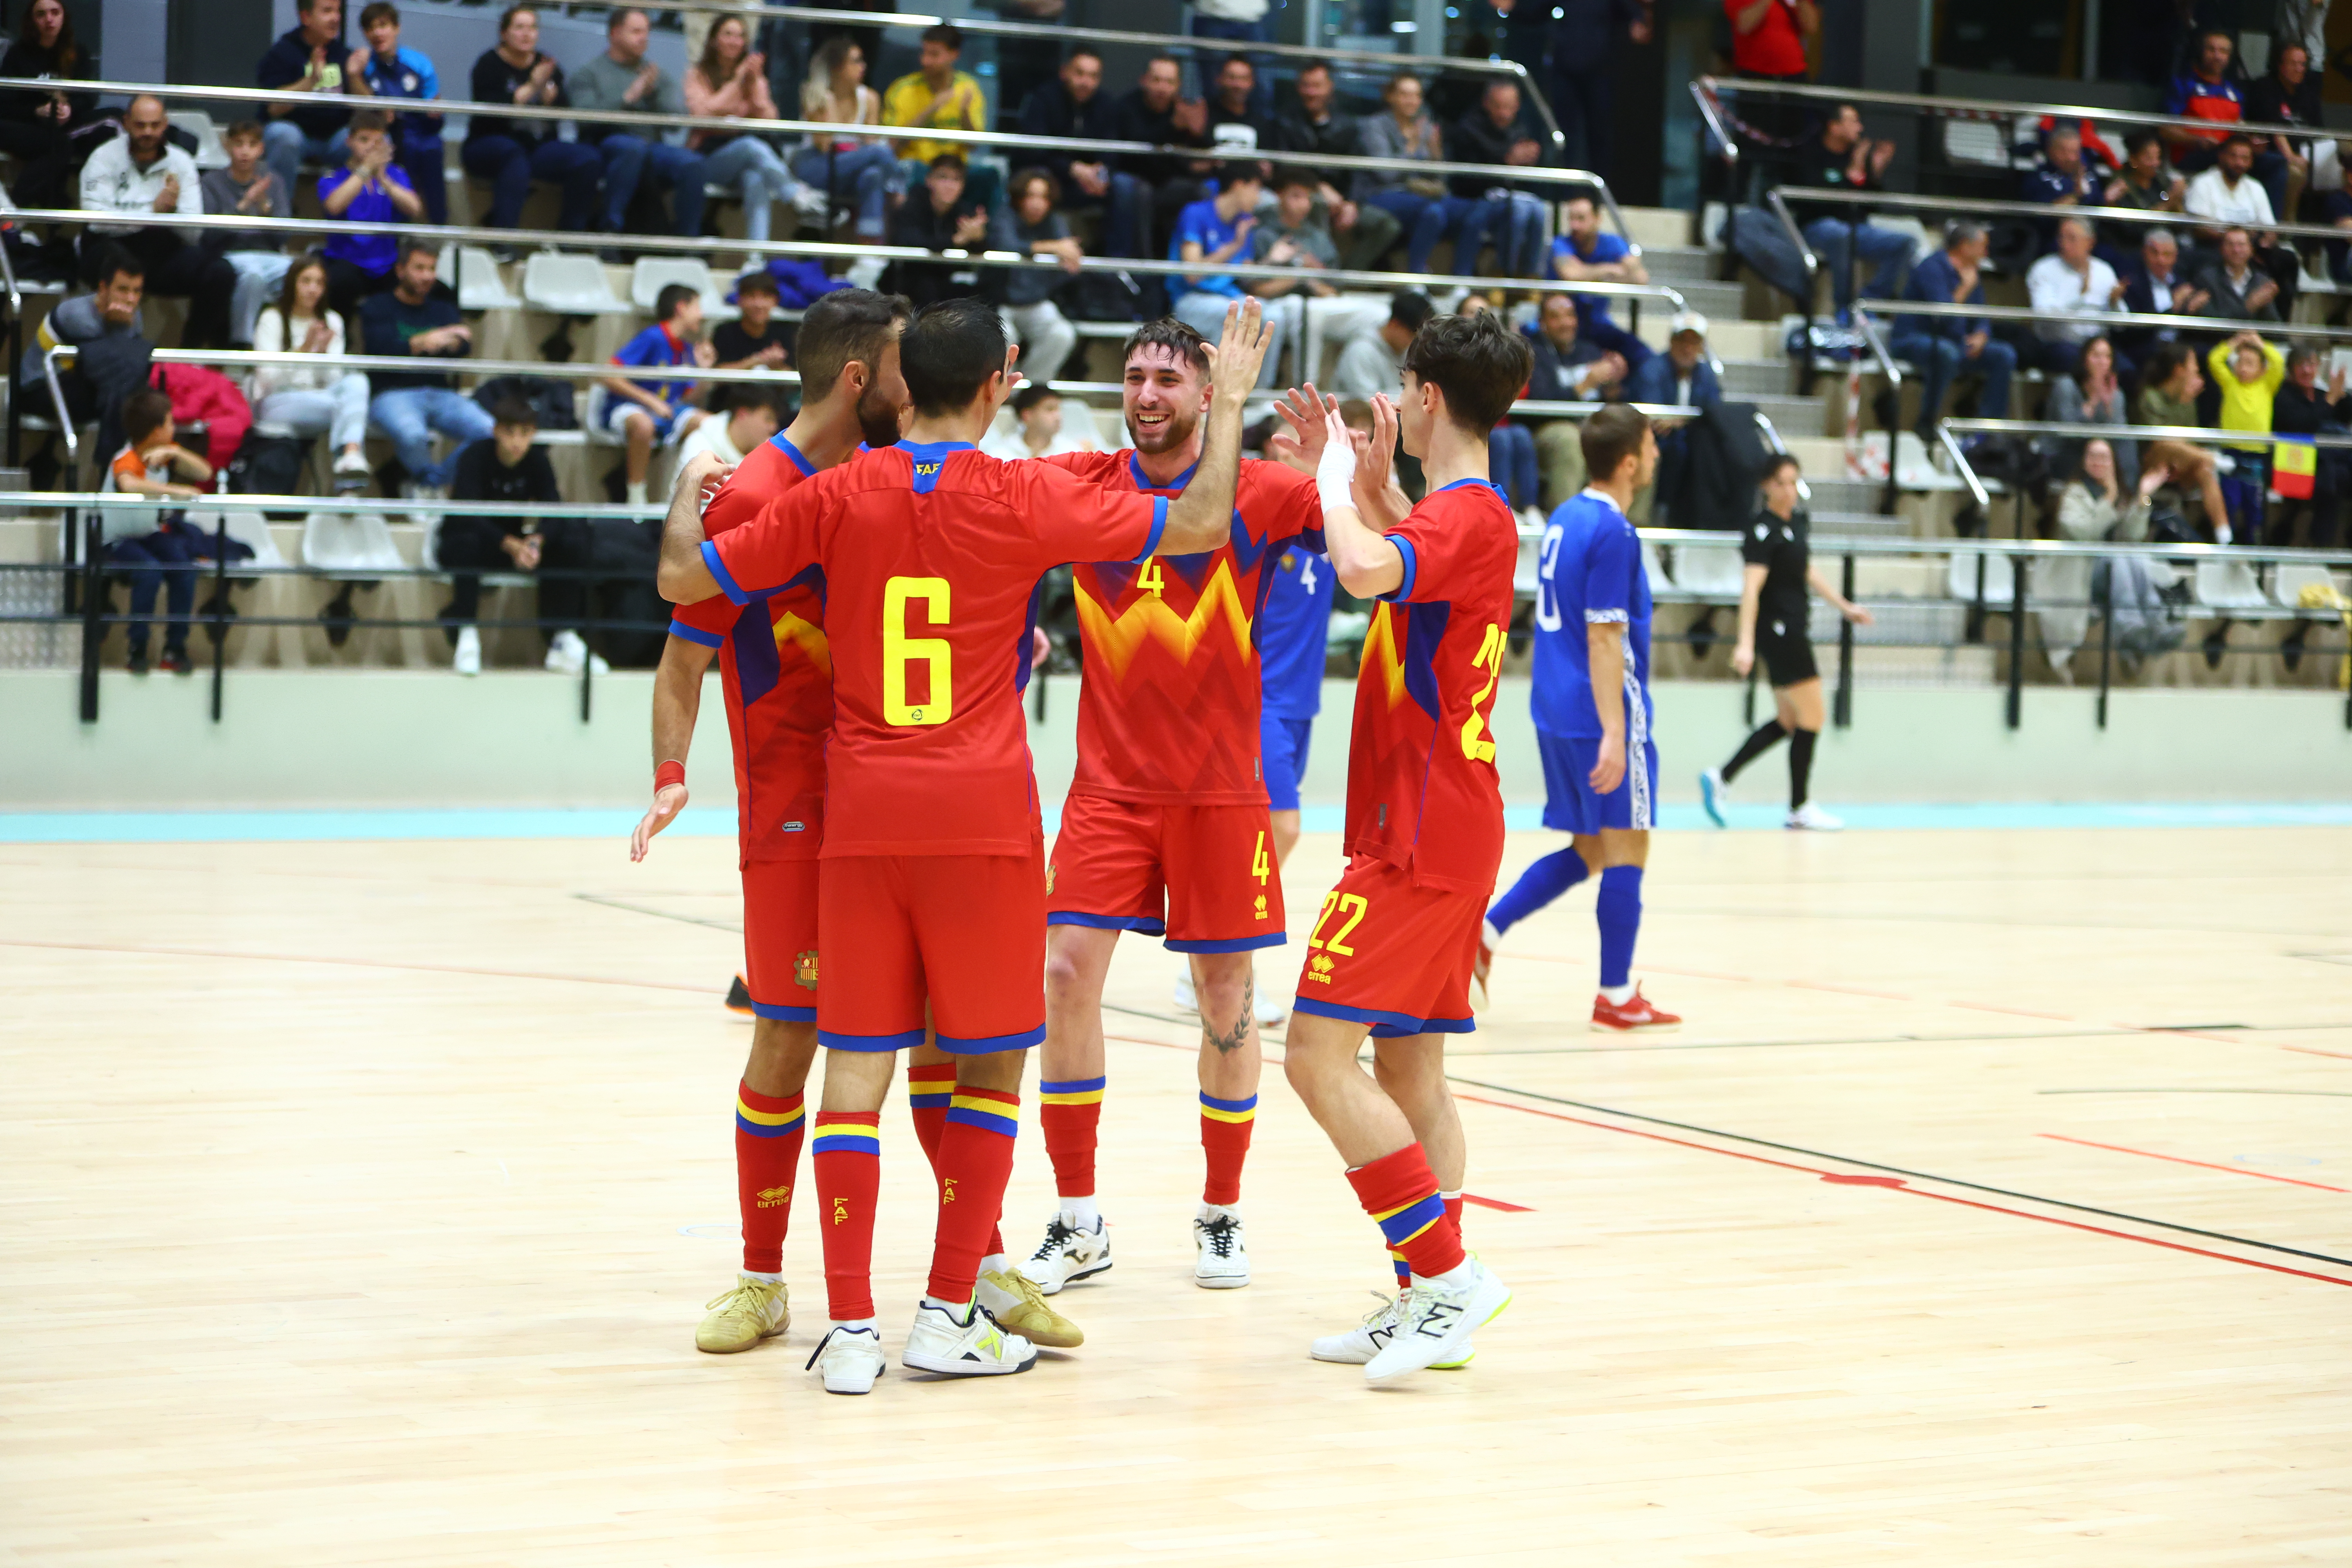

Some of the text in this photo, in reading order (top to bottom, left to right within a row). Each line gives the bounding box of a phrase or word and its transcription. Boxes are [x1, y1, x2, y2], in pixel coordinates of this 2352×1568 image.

[916, 463, 942, 476] FAF
[1137, 555, 1165, 598] 4
[1300, 555, 1318, 595] 4
[883, 576, 952, 726] 6
[1252, 831, 1270, 886] 4
[1309, 891, 1368, 956] 22
[1308, 971, 1331, 985] errea
[757, 1196, 789, 1208] errea
[944, 1178, 958, 1205] FAF
[834, 1197, 849, 1225] FAF
